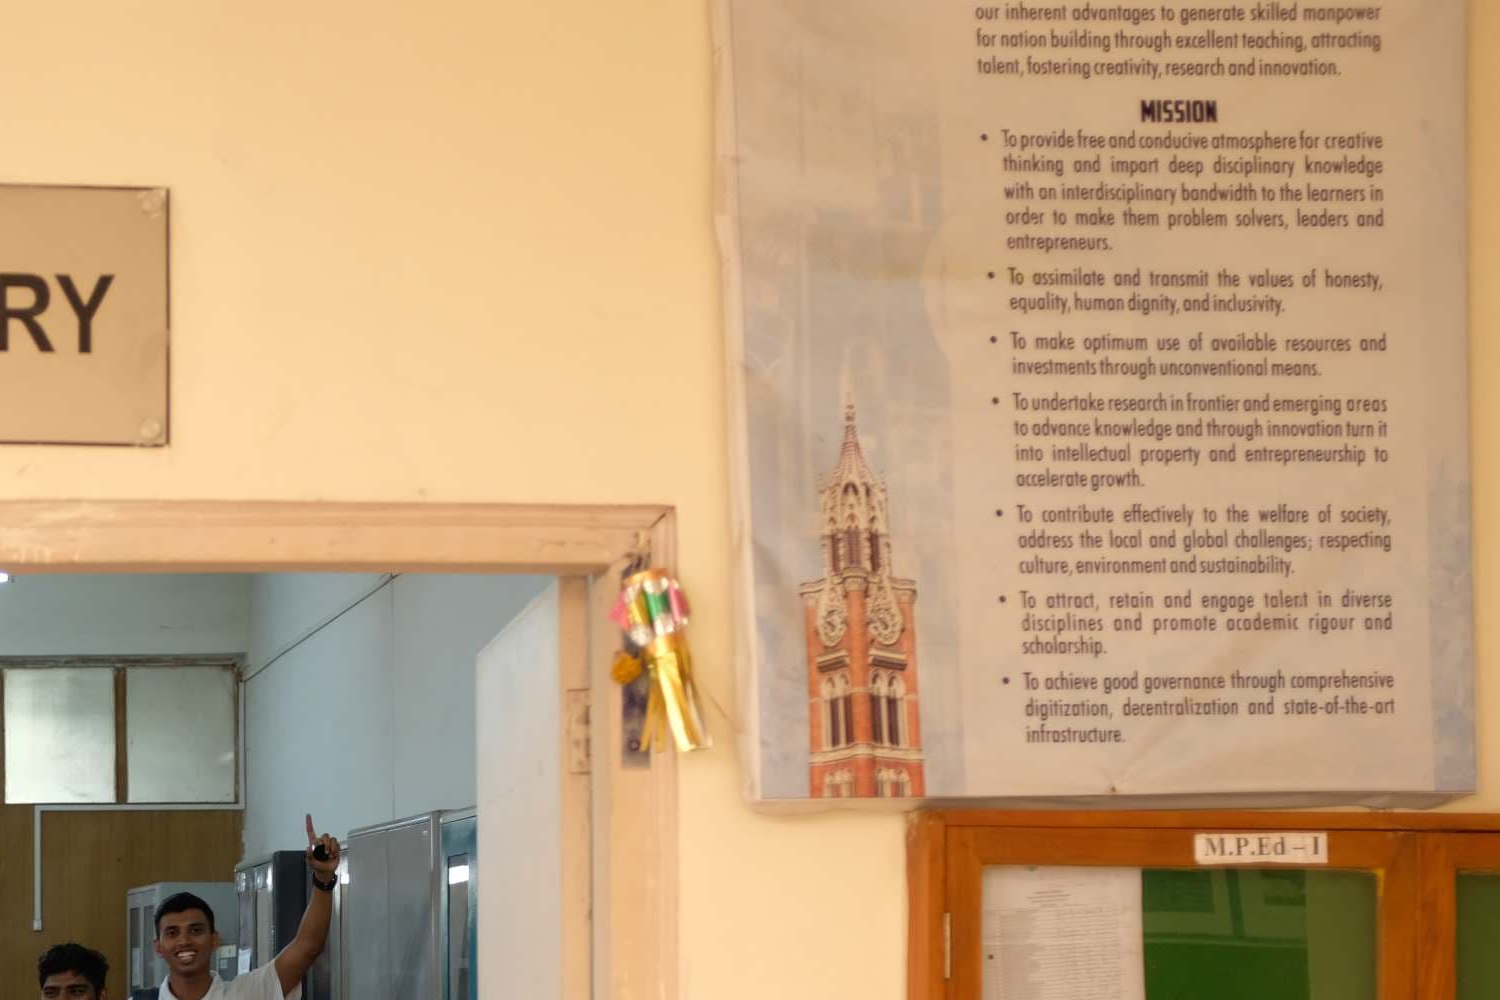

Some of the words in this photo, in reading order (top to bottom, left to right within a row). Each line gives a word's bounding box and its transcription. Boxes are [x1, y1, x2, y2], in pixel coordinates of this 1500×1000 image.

[974, 6, 1000, 20] our
[1005, 1, 1067, 20] inherent
[1071, 1, 1156, 25] advantages
[1160, 2, 1176, 20] to
[1179, 2, 1246, 25] generate
[1249, 1, 1298, 20] skilled
[1302, 6, 1382, 25] manpower
[976, 27, 997, 46] for
[1000, 27, 1047, 46] nation
[1050, 27, 1111, 51] building
[1114, 28, 1173, 52] through
[1175, 28, 1239, 48] excellent
[1241, 29, 1307, 53] teaching,
[1310, 29, 1383, 53] attracting
[978, 55, 1024, 77] talent,
[1026, 55, 1092, 79] fostering
[1093, 56, 1162, 80] creativity,
[1164, 56, 1226, 76] research
[1227, 57, 1256, 76] and
[1258, 57, 1341, 76] innovation.
[1140, 99, 1218, 124] MISSION
[1002, 129, 1018, 149] To
[1019, 129, 1075, 153] provide
[1076, 129, 1106, 149] free
[1107, 130, 1136, 149] and
[1138, 130, 1209, 149] conducive
[1211, 129, 1297, 153] atmosphere
[1299, 130, 1320, 149] for
[1323, 130, 1384, 149] creative
[1003, 153, 1064, 177] thinking
[1073, 153, 1101, 173] and
[1110, 154, 1159, 178] impart
[1168, 154, 1204, 178] deep
[1212, 154, 1295, 178] disciplinary
[1304, 155, 1384, 179] knowledge
[1005, 180, 1035, 200] with
[1038, 185, 1057, 200] an
[1061, 180, 1177, 204] interdisciplinary
[1180, 181, 1258, 201] bandwidth
[1261, 183, 1276, 201] to
[1279, 182, 1303, 201] the
[1306, 182, 1366, 201] learners
[1369, 182, 1385, 201] in
[1005, 206, 1045, 226] order
[1052, 207, 1068, 226] to
[1075, 206, 1115, 226] make
[1122, 207, 1160, 226] them
[1167, 207, 1228, 231] problem
[1235, 208, 1289, 230] solvers,
[1296, 208, 1349, 228] leaders
[1356, 208, 1385, 228] and
[1007, 232, 1114, 255] entrepreneurs.
[1009, 266, 1025, 286] To
[1031, 266, 1106, 286] assimilate
[1113, 266, 1141, 286] and
[1148, 267, 1209, 286] transmit
[1216, 267, 1241, 286] the
[1248, 267, 1295, 287] values
[1301, 267, 1317, 287] of
[1324, 267, 1384, 291] honesty,
[1010, 291, 1071, 315] equality,
[1073, 291, 1125, 311] human
[1127, 292, 1180, 316] dignity,
[1182, 293, 1211, 312] and
[1212, 293, 1286, 317] inclusivity.
[1011, 331, 1027, 351] To
[1034, 331, 1076, 351] make
[1083, 331, 1148, 355] optimum
[1156, 336, 1181, 351] use
[1188, 331, 1203, 351] of
[1210, 331, 1277, 351] available
[1284, 336, 1352, 351] resources
[1359, 331, 1388, 351] and
[1013, 355, 1098, 374] investments
[1099, 356, 1157, 380] through
[1159, 357, 1269, 376] unconventional
[1270, 362, 1322, 376] means.
[1014, 391, 1029, 411] To
[1031, 391, 1106, 411] undertake
[1107, 391, 1168, 411] research
[1170, 391, 1184, 411] in
[1186, 391, 1240, 411] frontier
[1242, 391, 1271, 411] and
[1272, 391, 1342, 415] emerging
[1345, 396, 1389, 411] areas
[1014, 418, 1029, 436] to
[1031, 417, 1091, 436] advance
[1094, 417, 1173, 441] knowledge
[1175, 417, 1203, 436] and
[1206, 417, 1263, 441] through
[1267, 417, 1343, 436] innovation
[1345, 418, 1375, 436] turn
[1377, 417, 1388, 436] it
[1016, 442, 1044, 462] into
[1052, 442, 1131, 462] intellectual
[1139, 444, 1201, 467] property
[1208, 443, 1237, 462] and
[1244, 443, 1366, 467] entrepreneurship
[1373, 444, 1389, 463] to
[1016, 467, 1089, 486] accelerate
[1089, 467, 1145, 491] growth.
[1017, 502, 1033, 522] To
[1041, 502, 1115, 522] contribute
[1122, 503, 1194, 527] effectively
[1202, 504, 1218, 522] to
[1225, 503, 1250, 522] the
[1257, 503, 1310, 523] welfare
[1317, 503, 1332, 523] of
[1340, 503, 1392, 527] society,
[1018, 528, 1074, 548] address
[1079, 528, 1103, 548] the
[1109, 528, 1143, 548] local
[1148, 529, 1177, 548] and
[1182, 529, 1229, 553] global
[1234, 529, 1313, 553] challenges;
[1319, 529, 1393, 553] respecting
[1019, 555, 1073, 577] culture,
[1075, 555, 1167, 574] environment
[1169, 555, 1198, 574] and
[1199, 555, 1295, 579] sustainability.
[1020, 589, 1037, 608] To
[1045, 590, 1100, 611] attract,
[1109, 589, 1154, 608] retain
[1163, 588, 1192, 608] and
[1200, 593, 1255, 612] engage
[1264, 588, 1309, 607] talent
[1317, 588, 1332, 607] in
[1340, 588, 1393, 607] diverse
[1022, 611, 1104, 635] disciplines
[1113, 611, 1143, 630] and
[1152, 612, 1217, 635] promote
[1226, 611, 1299, 630] academic
[1308, 611, 1354, 635] rigour
[1364, 611, 1394, 630] and
[1023, 635, 1108, 659] scholarship.
[1023, 670, 1040, 690] To
[1044, 670, 1099, 690] achieve
[1102, 670, 1139, 694] good
[1143, 674, 1226, 694] governance
[1230, 669, 1286, 693] through
[1290, 669, 1395, 693] comprehensive
[1025, 697, 1113, 721] digitization,
[1122, 696, 1239, 716] decentralization
[1247, 695, 1275, 715] and
[1283, 695, 1396, 714] state-of-the-art
[1026, 723, 1126, 742] infrastructure.
[1204, 836, 1285, 856] M.P.Ed
